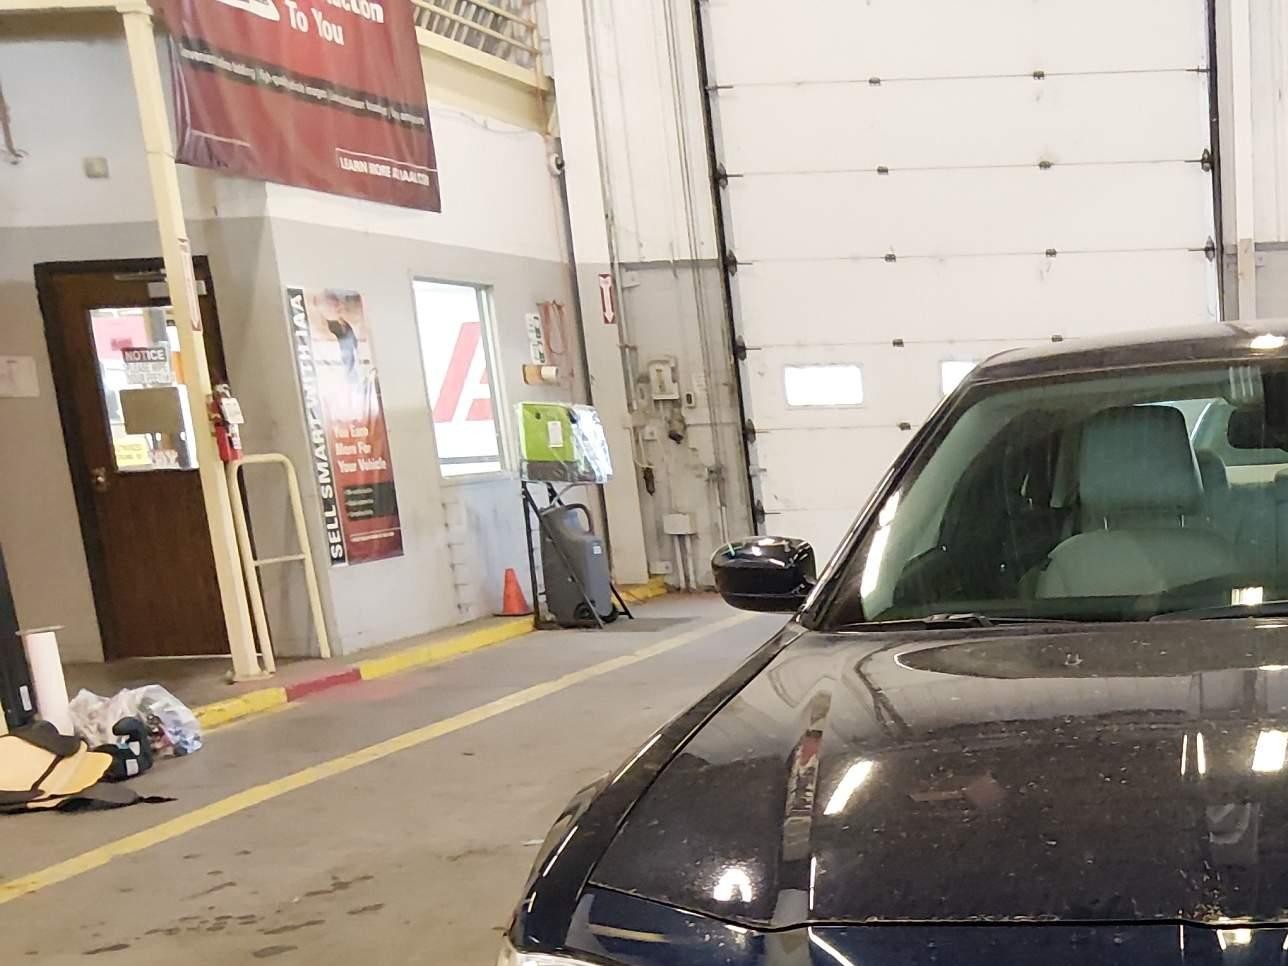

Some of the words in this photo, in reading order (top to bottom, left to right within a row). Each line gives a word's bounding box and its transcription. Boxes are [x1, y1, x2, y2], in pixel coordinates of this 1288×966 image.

[285, 0, 308, 32] To
[311, 8, 344, 45] You
[291, 294, 309, 337] IAA
[124, 350, 166, 361] NOTICE
[309, 417, 333, 499] SMART
[324, 504, 343, 559] SELL
